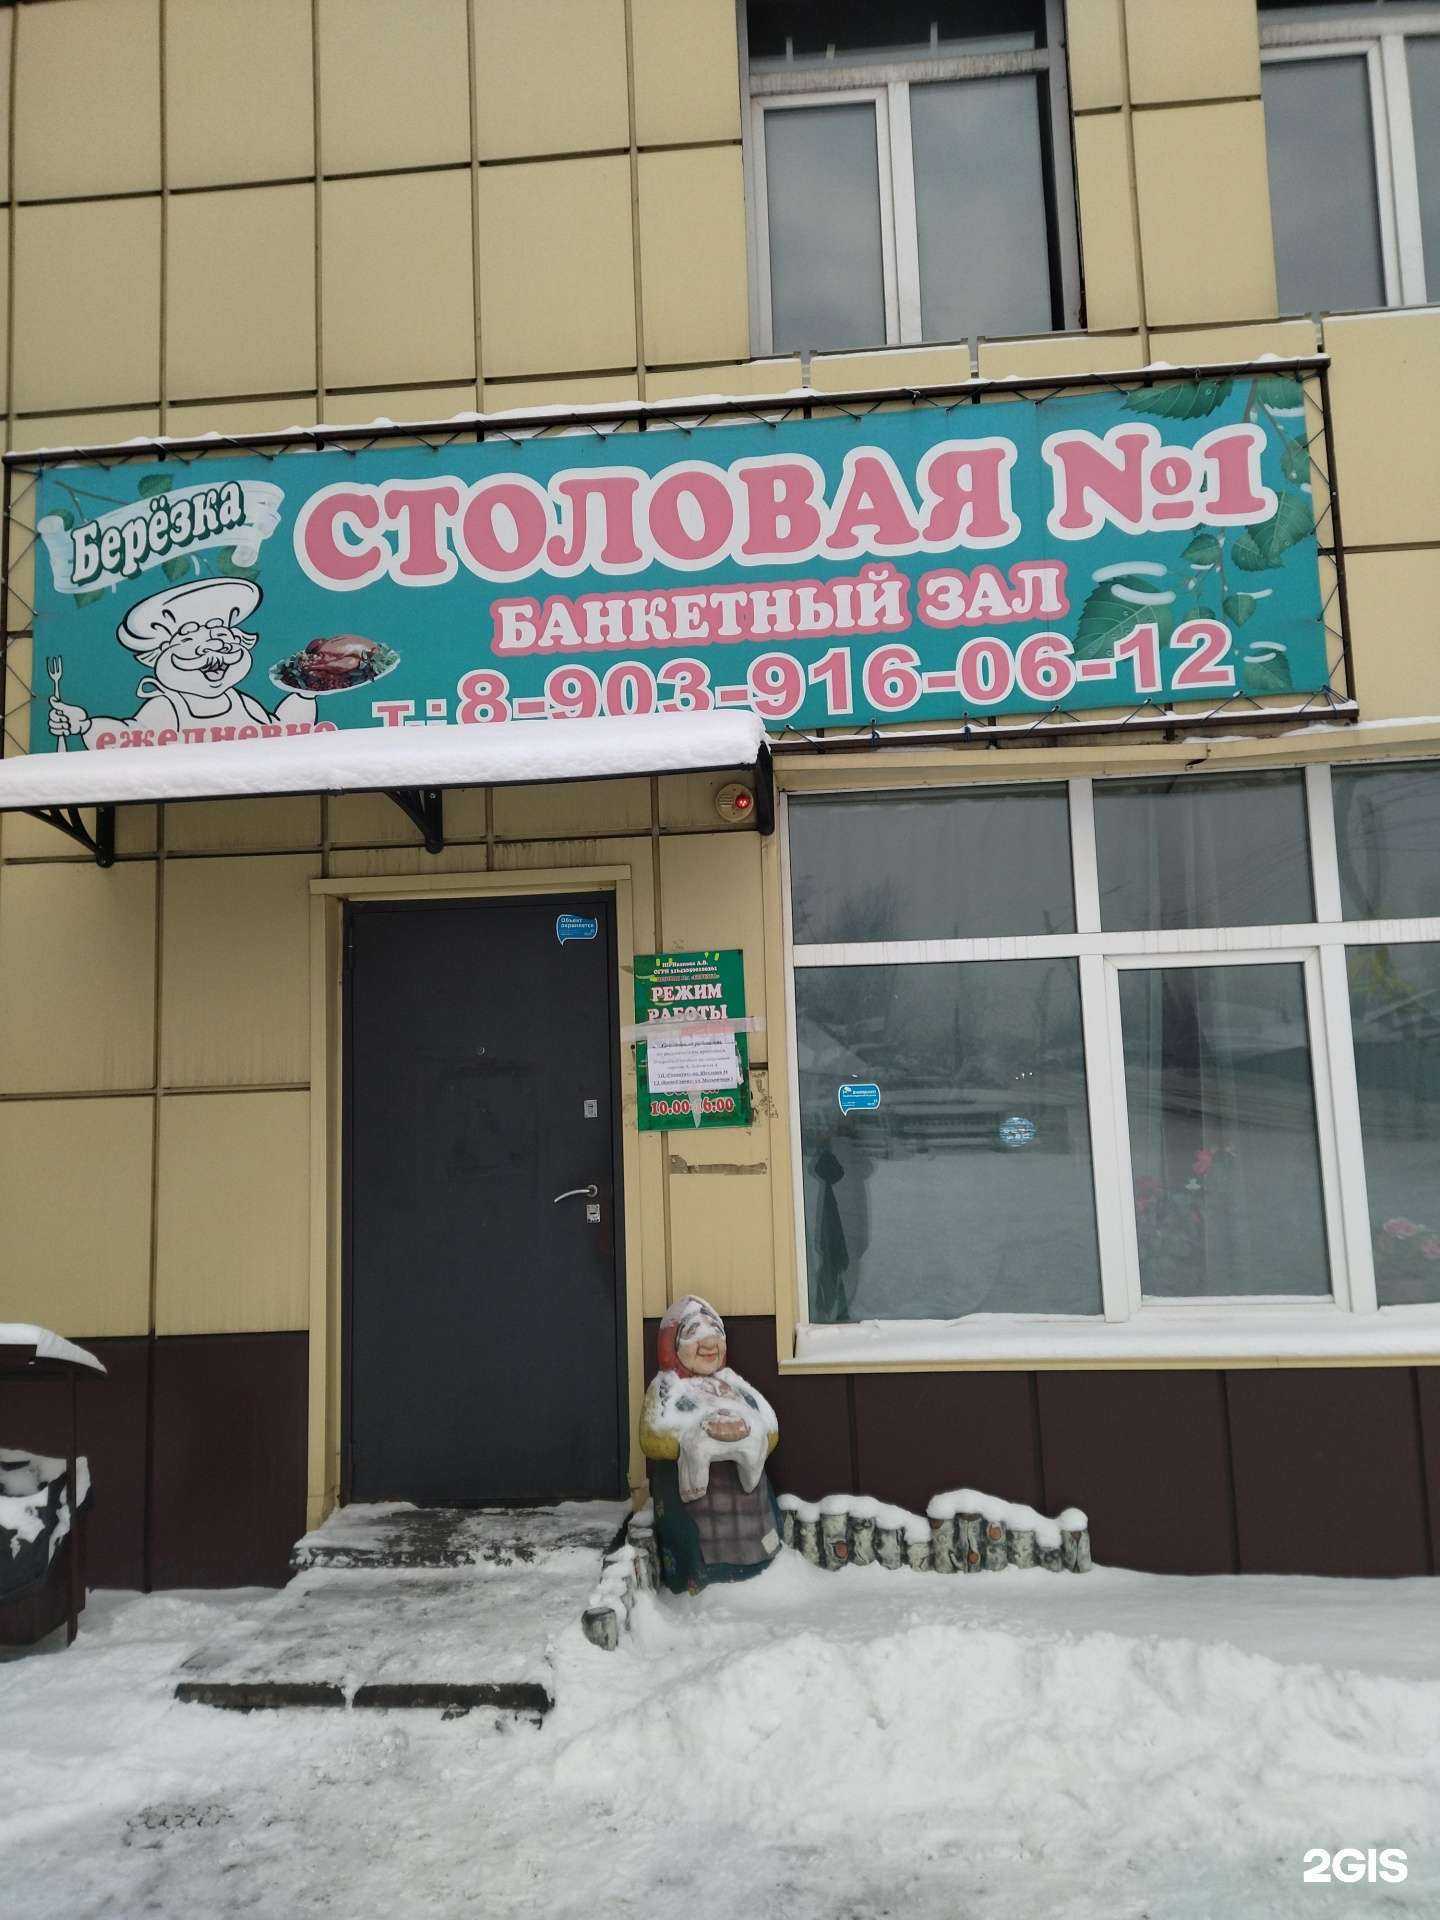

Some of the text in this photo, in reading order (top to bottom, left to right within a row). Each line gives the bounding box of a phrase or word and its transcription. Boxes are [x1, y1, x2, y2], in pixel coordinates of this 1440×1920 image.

[71, 481, 246, 585] Берёзка
[303, 432, 1269, 581] СТОЛОВАЯ №1
[498, 564, 1063, 650] БАНКЕТНЫЙ ЗАЛ
[647, 1004, 729, 1021] РАБОТЫ
[651, 983, 723, 1002] РЕЖИМ
